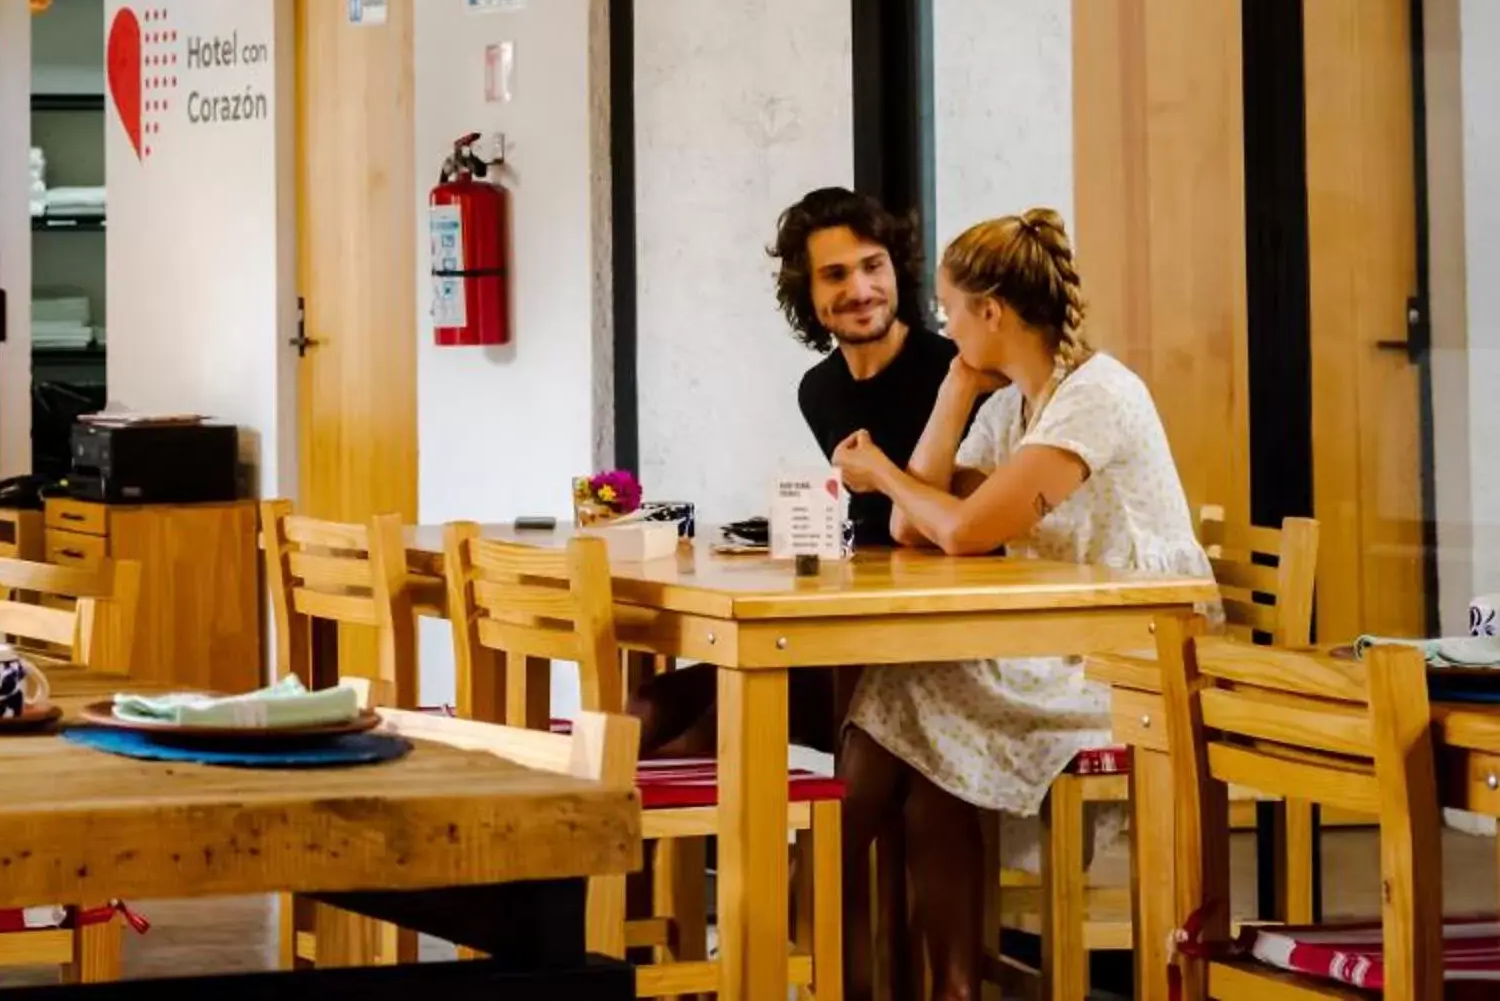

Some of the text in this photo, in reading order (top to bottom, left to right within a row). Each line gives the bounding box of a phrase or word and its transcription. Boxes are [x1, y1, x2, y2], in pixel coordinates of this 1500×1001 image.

[187, 29, 268, 69] Hotel con
[187, 84, 267, 124] Corazón
